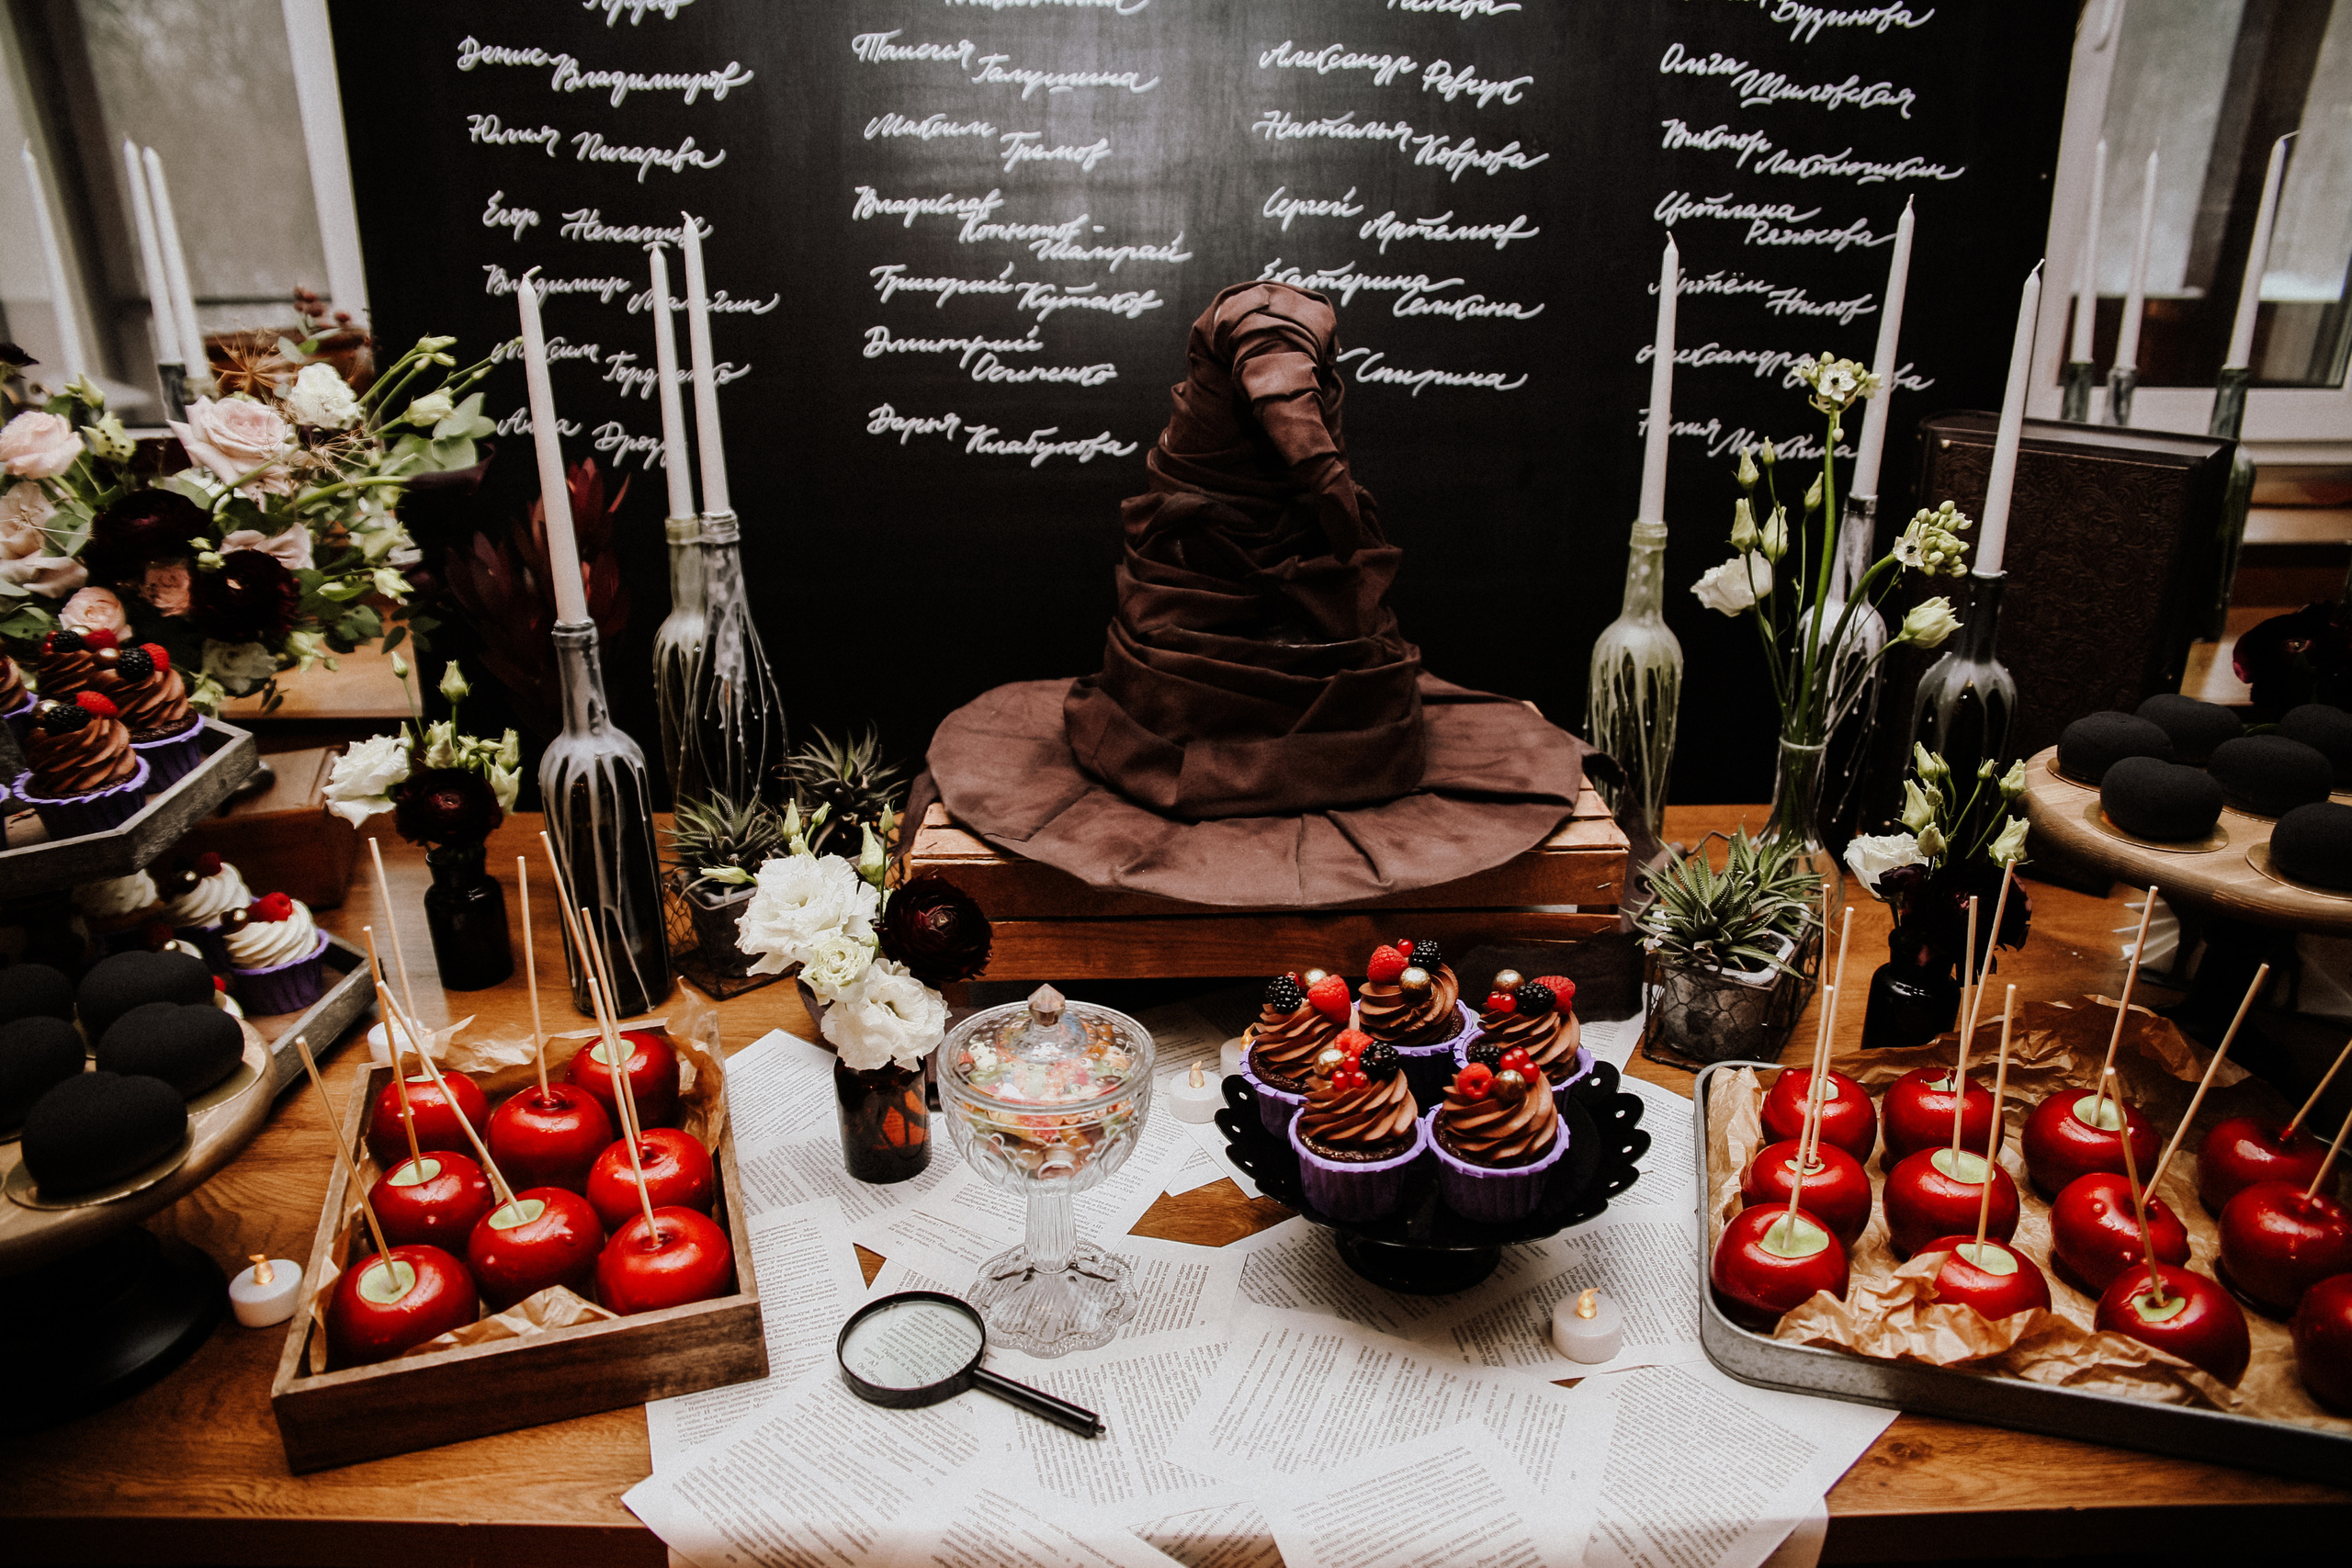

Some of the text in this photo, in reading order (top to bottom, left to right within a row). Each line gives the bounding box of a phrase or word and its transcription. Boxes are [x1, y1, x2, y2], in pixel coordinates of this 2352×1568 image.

[458, 35, 754, 107] Денис Владимиров
[852, 28, 976, 70] Таисия
[1659, 42, 1748, 75] Ольга
[1260, 40, 1533, 108] Александр Ревчук
[467, 114, 560, 157] Юлия
[864, 112, 997, 141] Максим
[1252, 110, 1549, 183] Наталья Коврова
[1661, 118, 1965, 185] Виктор Лактюшкин
[483, 190, 540, 242] Егор
[852, 185, 1004, 228] Владислав
[1262, 186, 1364, 231] Сергей
[1654, 190, 1822, 227] Светлана
[1029, 231, 1193, 274] Шамрай
[870, 262, 1163, 321] Григорий Кутаков
[1256, 257, 1464, 307] Екатерина
[1765, 288, 1877, 325] Нилов
[864, 325, 1117, 387] Дмитрий Осипенко
[1356, 352, 1529, 398] Спирина
[866, 402, 961, 446] Дарья
[940, 1325, 958, 1339] Гарри
[881, 1347, 899, 1364] Гарри,
